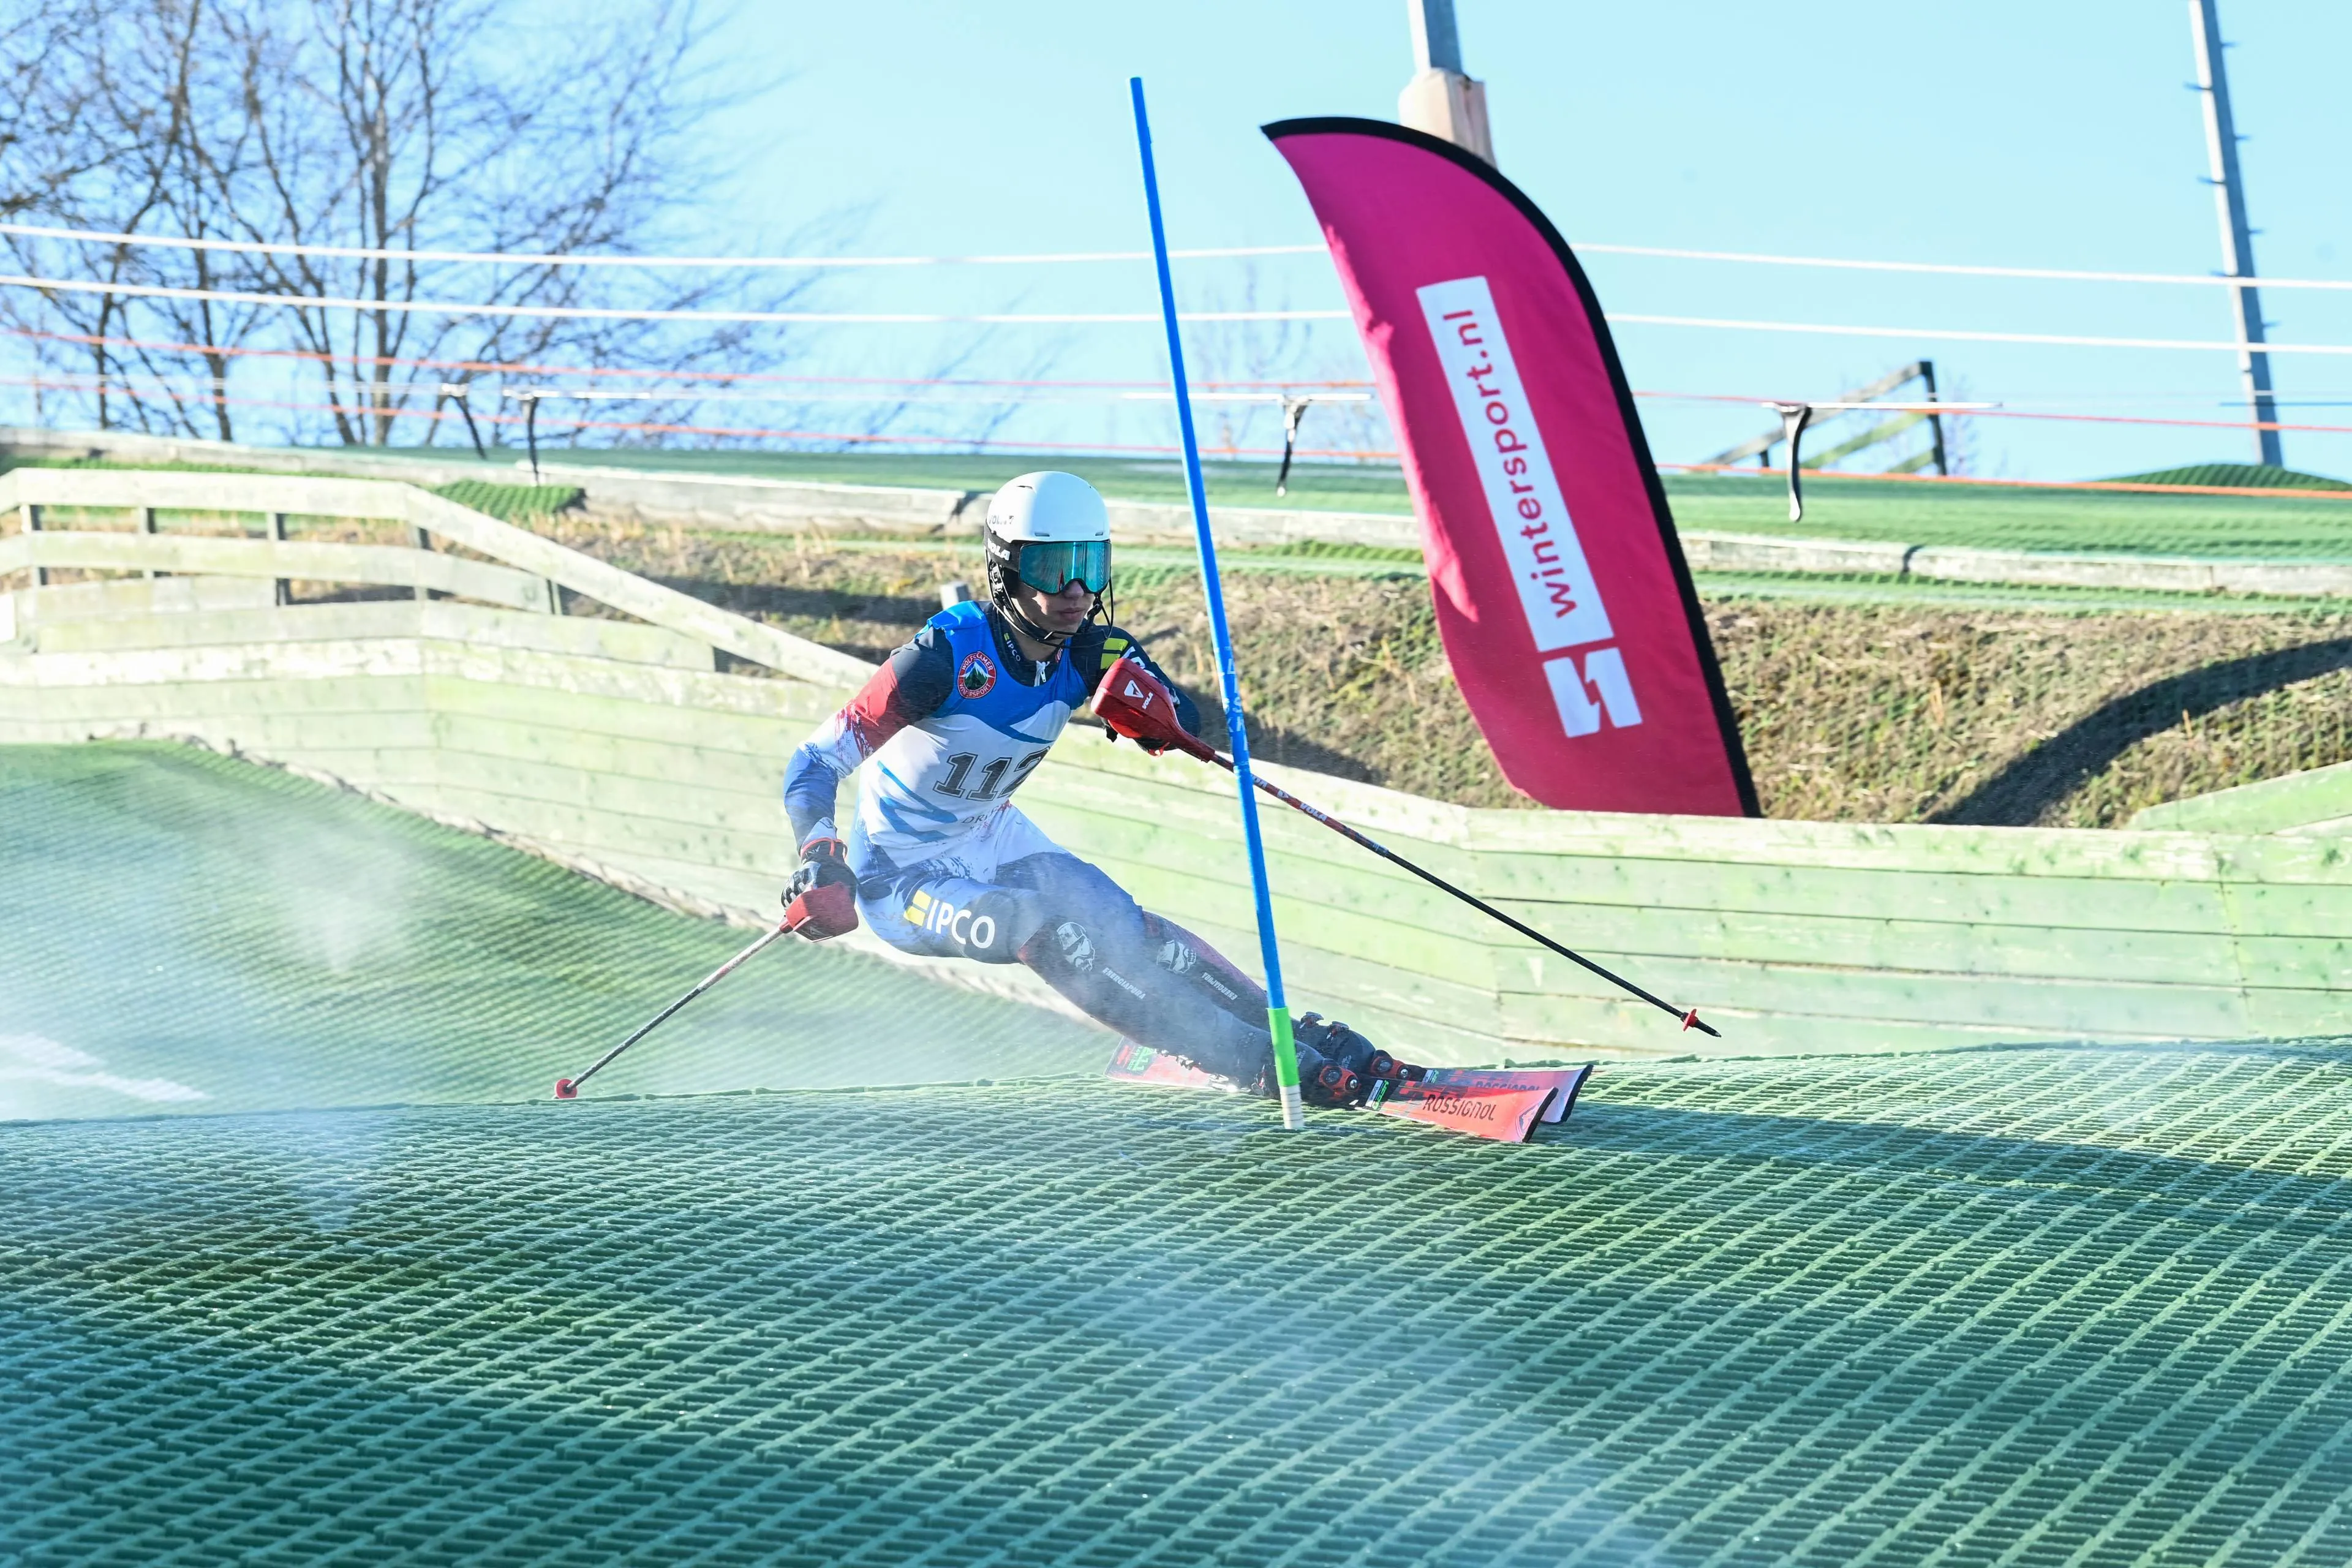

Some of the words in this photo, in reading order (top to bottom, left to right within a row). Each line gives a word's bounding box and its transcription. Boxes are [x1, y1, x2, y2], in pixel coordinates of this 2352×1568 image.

[1442, 309, 1577, 617] wintersport.nl
[1006, 640, 1021, 662] IPCO
[1142, 692, 1154, 710] VOLA
[932, 746, 1050, 801] 112
[1300, 802, 1328, 822] VOLA
[926, 899, 995, 949] IPCO
[1102, 967, 1146, 1000] ENERGIAPURA
[1201, 972, 1238, 1001] ENERGIAPURA
[1423, 1094, 1496, 1121] ROSSIGNOL
